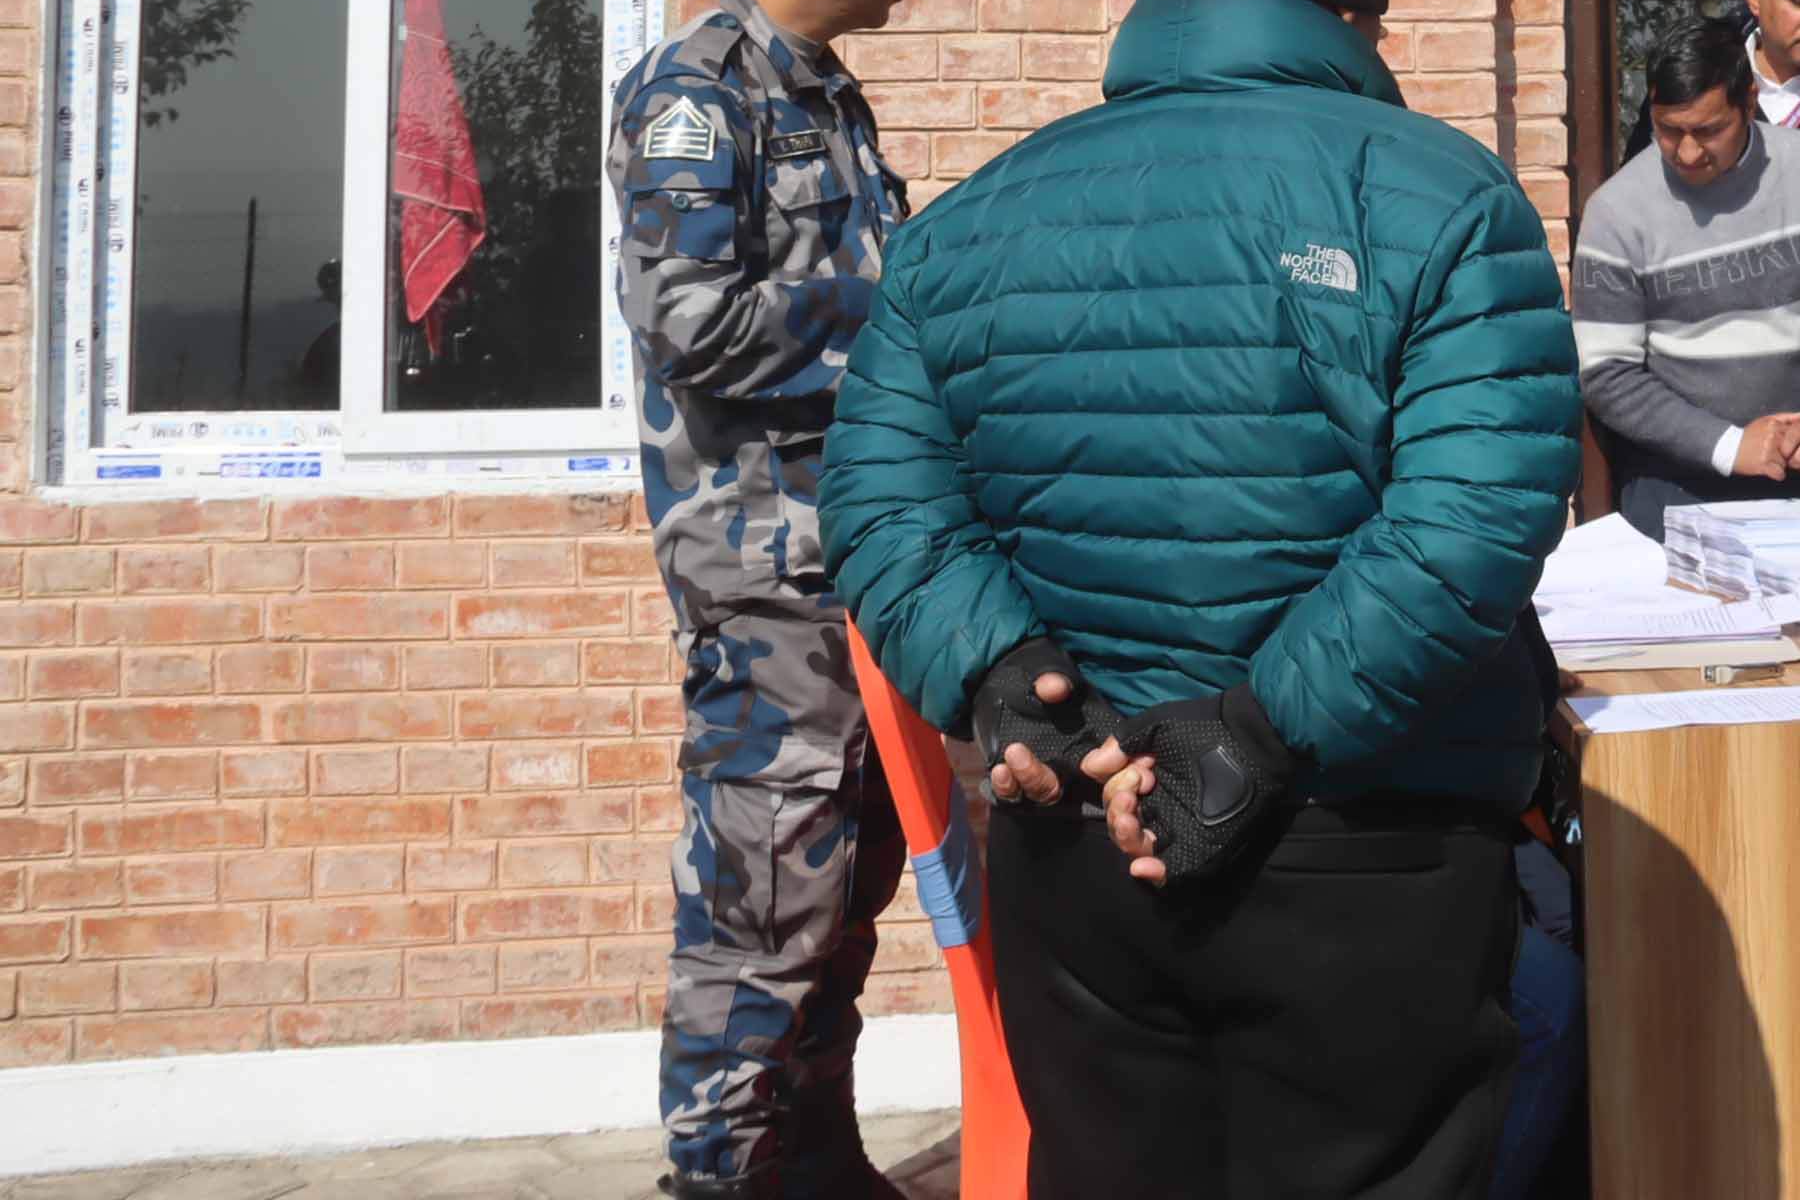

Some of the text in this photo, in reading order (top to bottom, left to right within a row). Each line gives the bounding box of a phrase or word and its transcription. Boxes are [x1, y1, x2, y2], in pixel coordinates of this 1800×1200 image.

[1306, 243, 1336, 260] THE
[1280, 252, 1333, 275] NORTH
[1291, 269, 1334, 285] FACE
